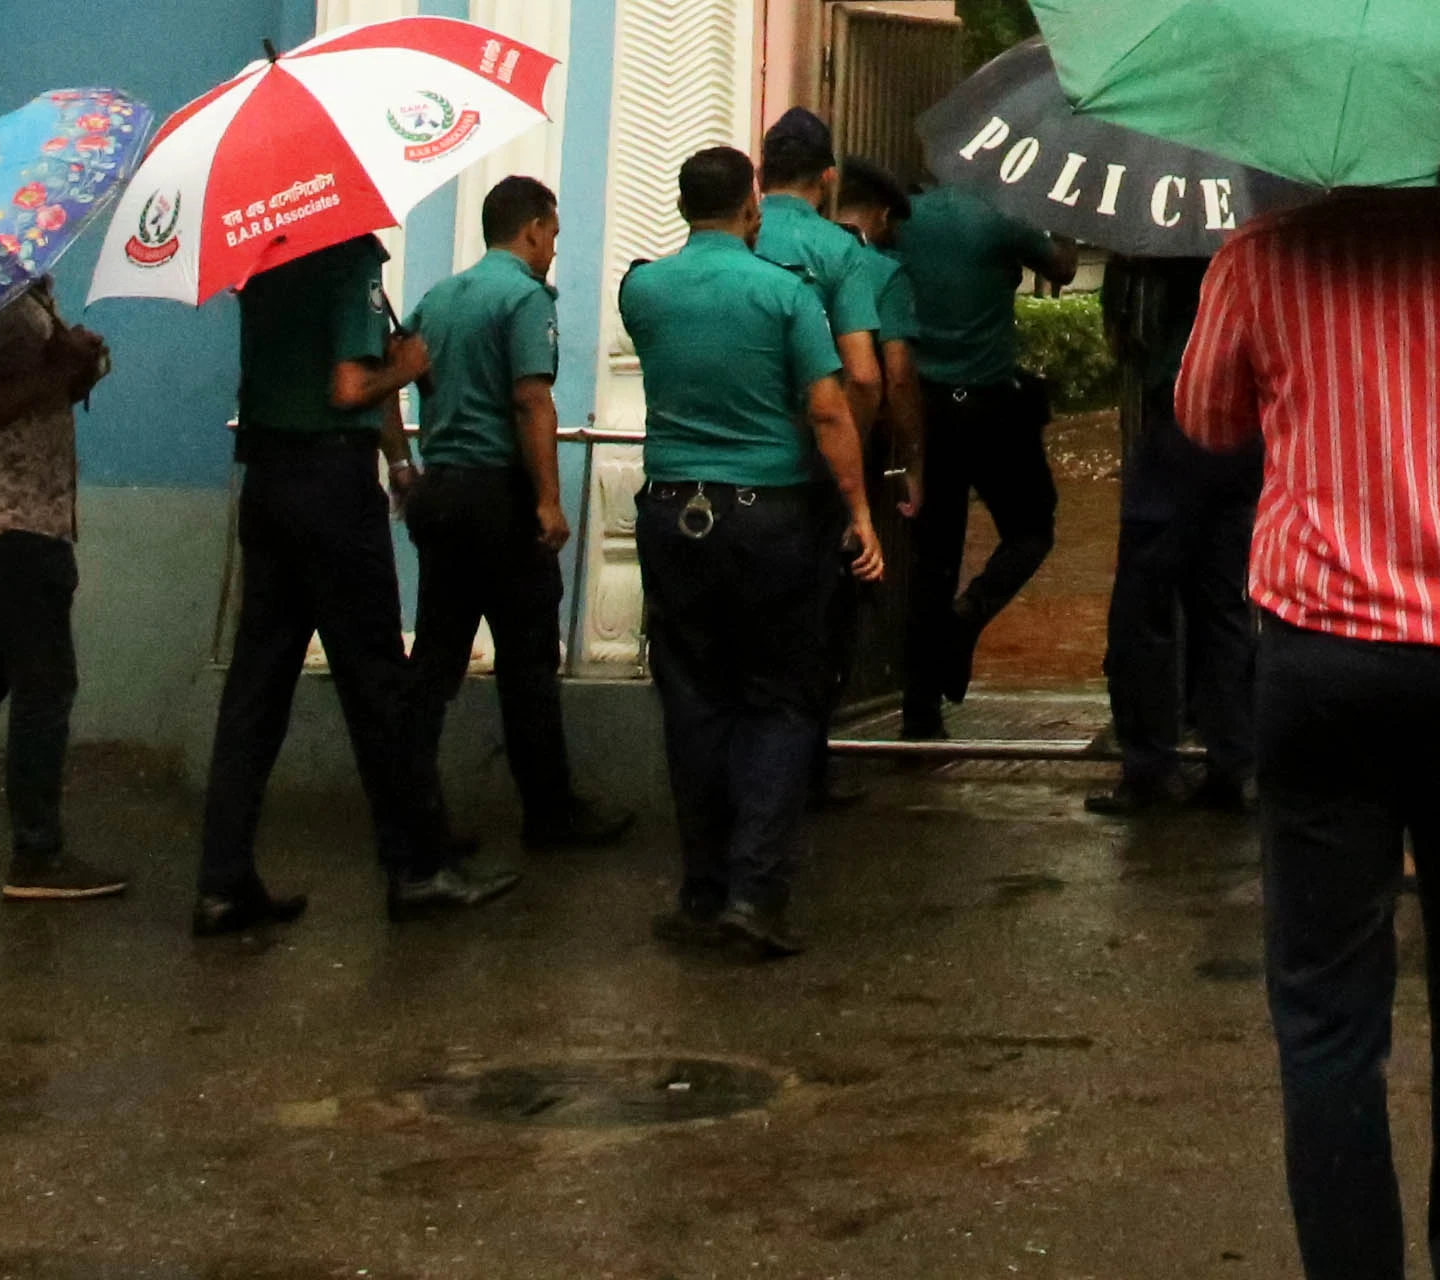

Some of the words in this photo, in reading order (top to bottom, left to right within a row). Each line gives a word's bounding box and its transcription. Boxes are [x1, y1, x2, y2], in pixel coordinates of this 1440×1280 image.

[959, 116, 1236, 230] POLICE
[226, 221, 263, 248] B.A.R
[263, 217, 274, 232] &
[275, 193, 340, 228] Associates
